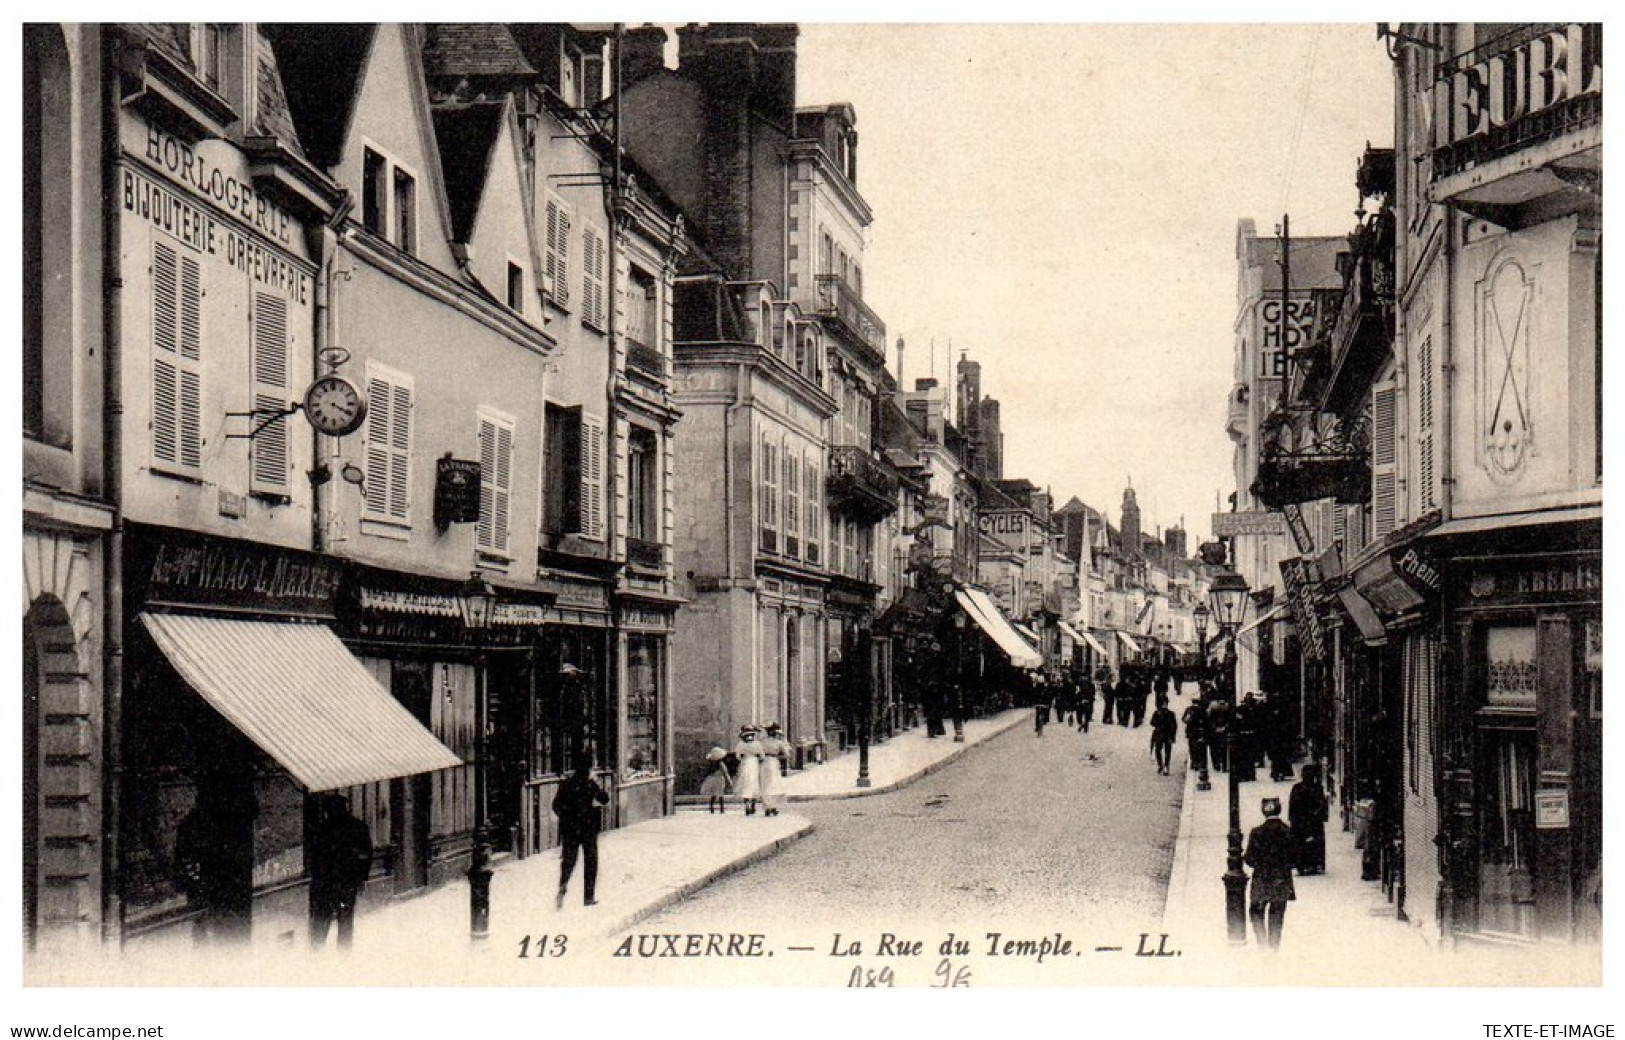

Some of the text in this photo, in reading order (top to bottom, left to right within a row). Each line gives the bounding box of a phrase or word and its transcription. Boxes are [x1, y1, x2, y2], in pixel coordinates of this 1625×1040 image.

[124, 169, 214, 255] BIJOUTERIE
[146, 126, 290, 244] HORLOGERIE
[978, 514, 1023, 534] CYCLES
